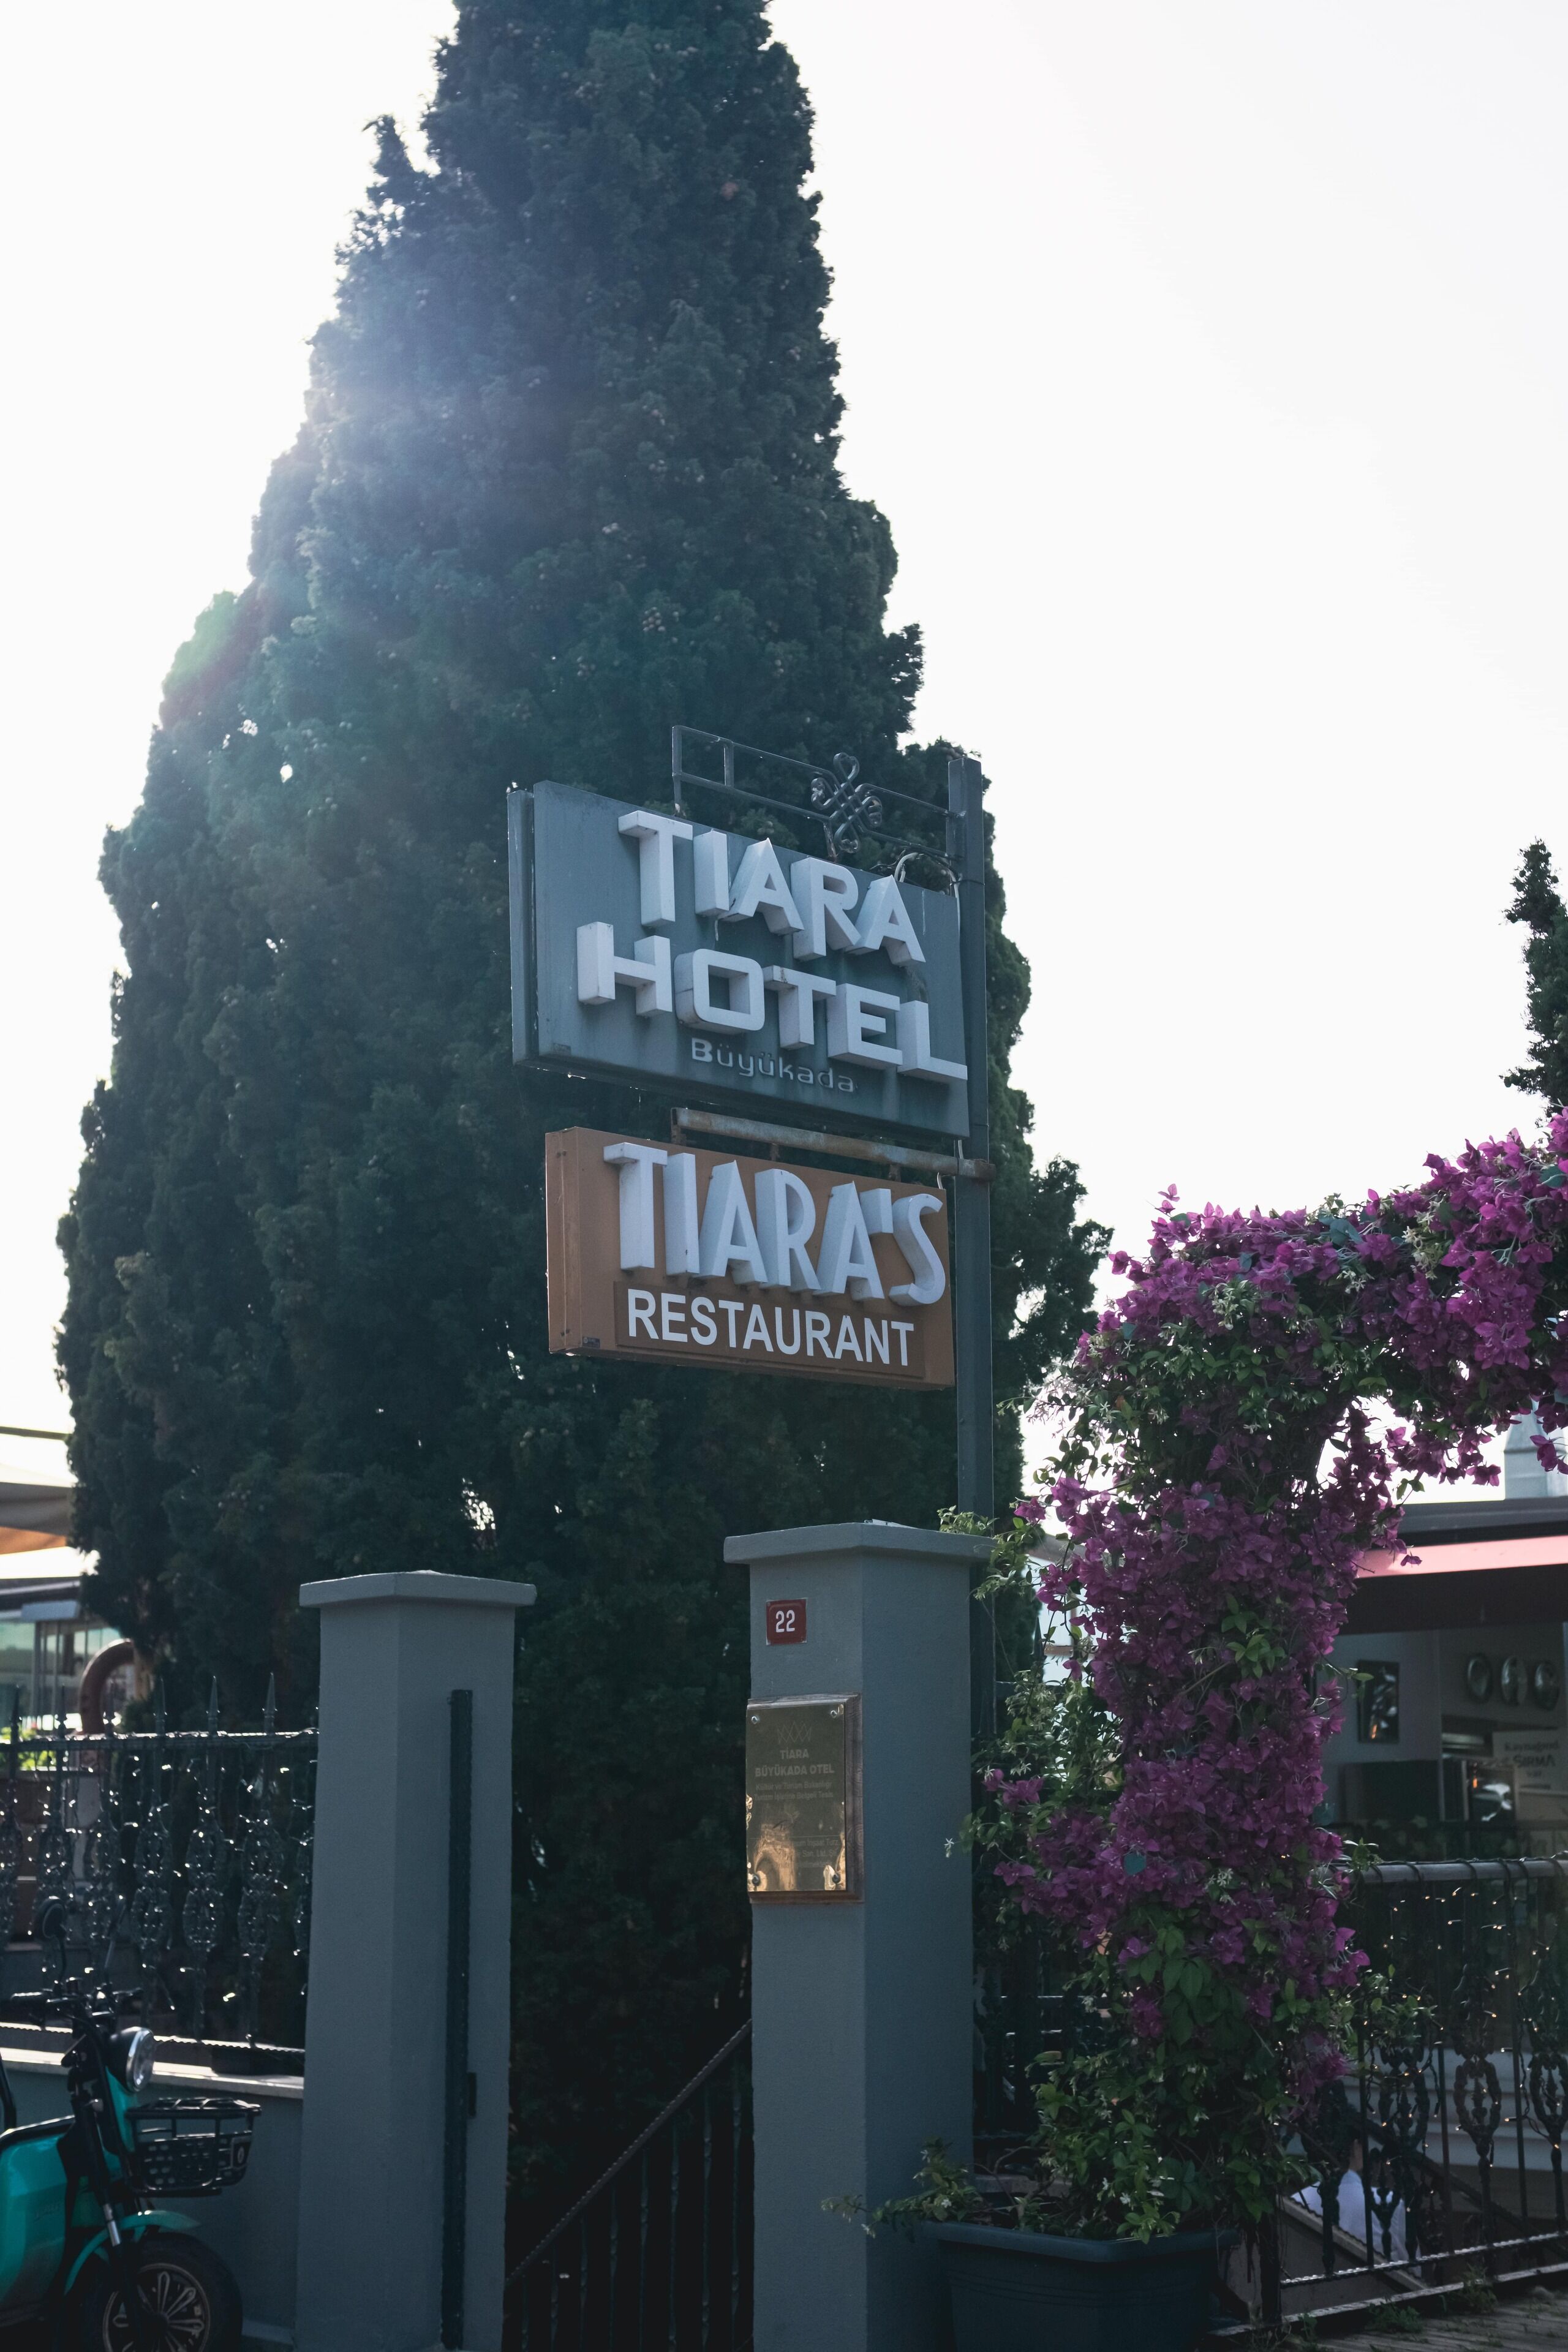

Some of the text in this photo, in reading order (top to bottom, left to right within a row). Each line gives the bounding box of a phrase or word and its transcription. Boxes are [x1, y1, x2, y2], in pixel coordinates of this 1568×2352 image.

[619, 810, 926, 968] TIARA
[576, 921, 968, 1086] HOTEL
[692, 1038, 854, 1092] Büyükada
[603, 1142, 946, 1306] TIARA'S
[627, 1288, 914, 1366] RESTAURANT
[775, 1610, 795, 1633] 22
[754, 1763, 835, 1777] BÜYÜKADA OTEL
